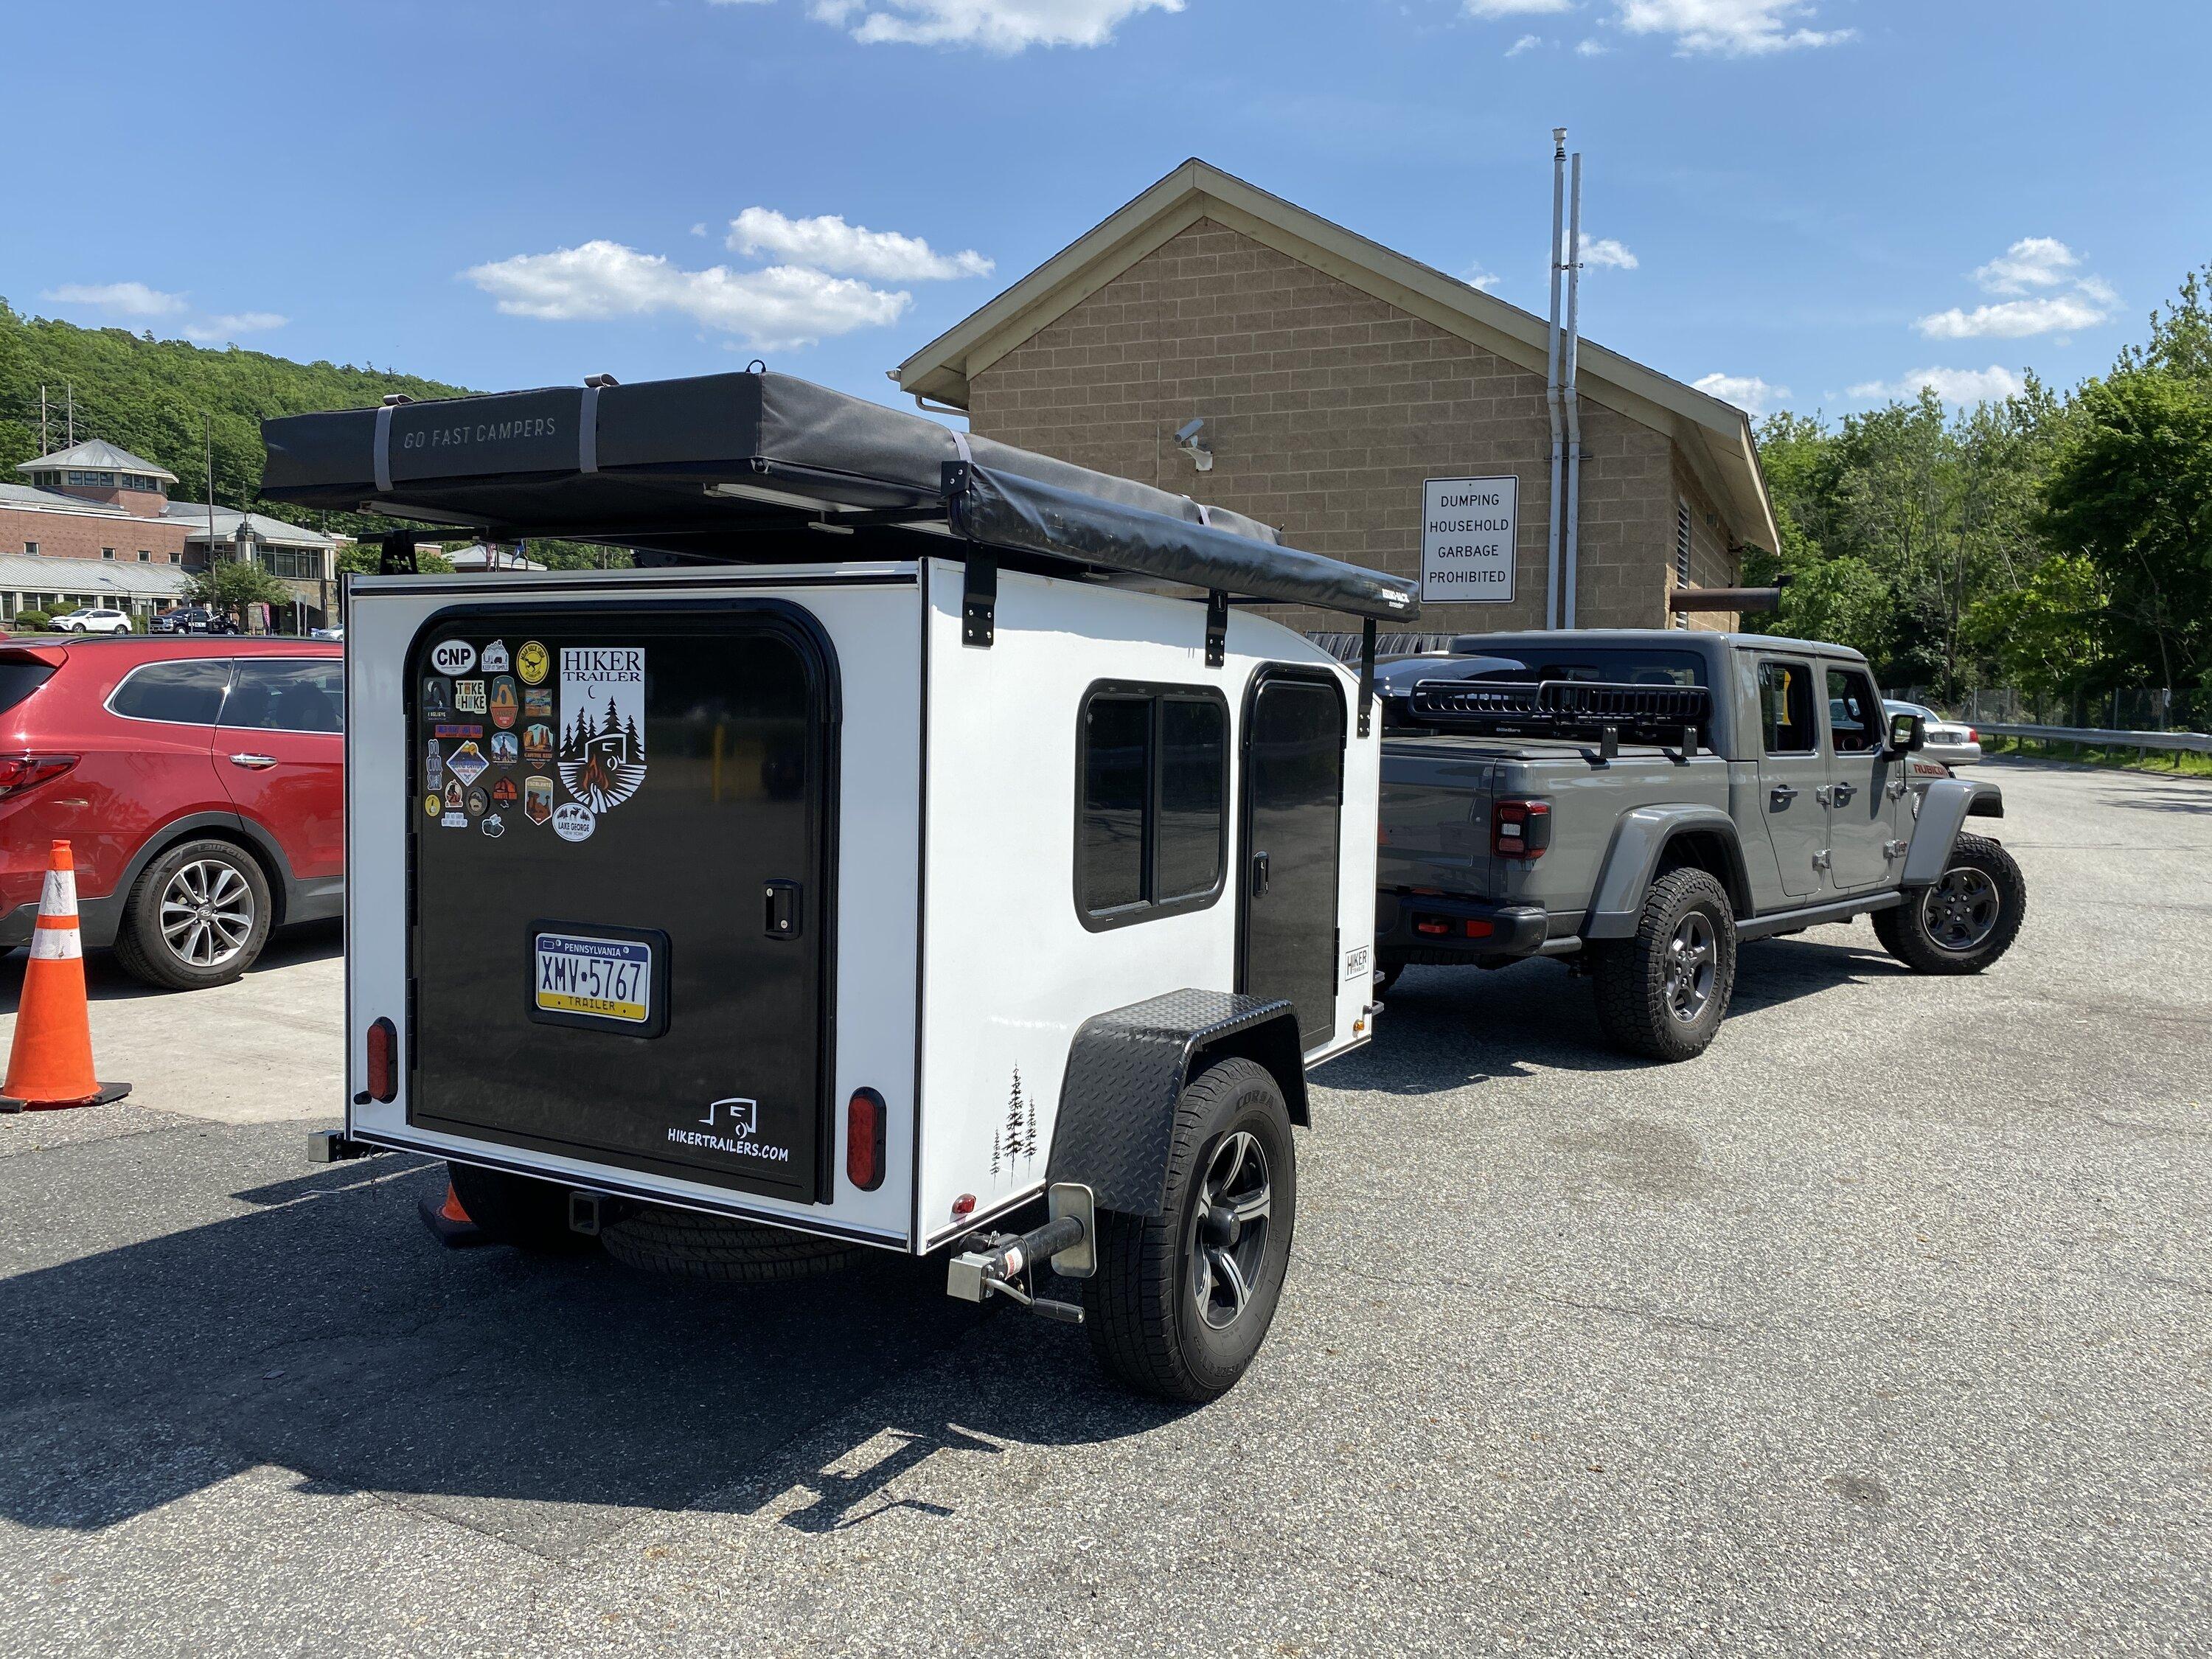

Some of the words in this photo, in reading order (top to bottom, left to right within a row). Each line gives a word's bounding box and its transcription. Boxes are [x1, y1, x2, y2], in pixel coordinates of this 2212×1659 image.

[404, 431, 425, 448] GO
[431, 426, 471, 447] FAST
[476, 417, 555, 442] CAMPERS
[1441, 493, 1500, 507] DUMPING
[1430, 519, 1509, 532] HOUSEHOLD
[1438, 545, 1499, 558] GARBAGE
[1429, 571, 1506, 583] PROHIBITED
[437, 649, 471, 666] CNP
[563, 651, 642, 671] HIKER
[563, 672, 642, 682] TRAILER
[457, 682, 483, 695] TKE
[461, 695, 484, 709] HKE
[558, 821, 570, 830] LAKE
[571, 823, 590, 832] GEORGE
[564, 942, 622, 957] PENNSYLVANIA
[1347, 950, 1367, 975] HIKER
[568, 996, 616, 1011] TRAILER
[1235, 1090, 1275, 1113] CORSA
[667, 1127, 789, 1162] HIKERTRAILERS.COM
